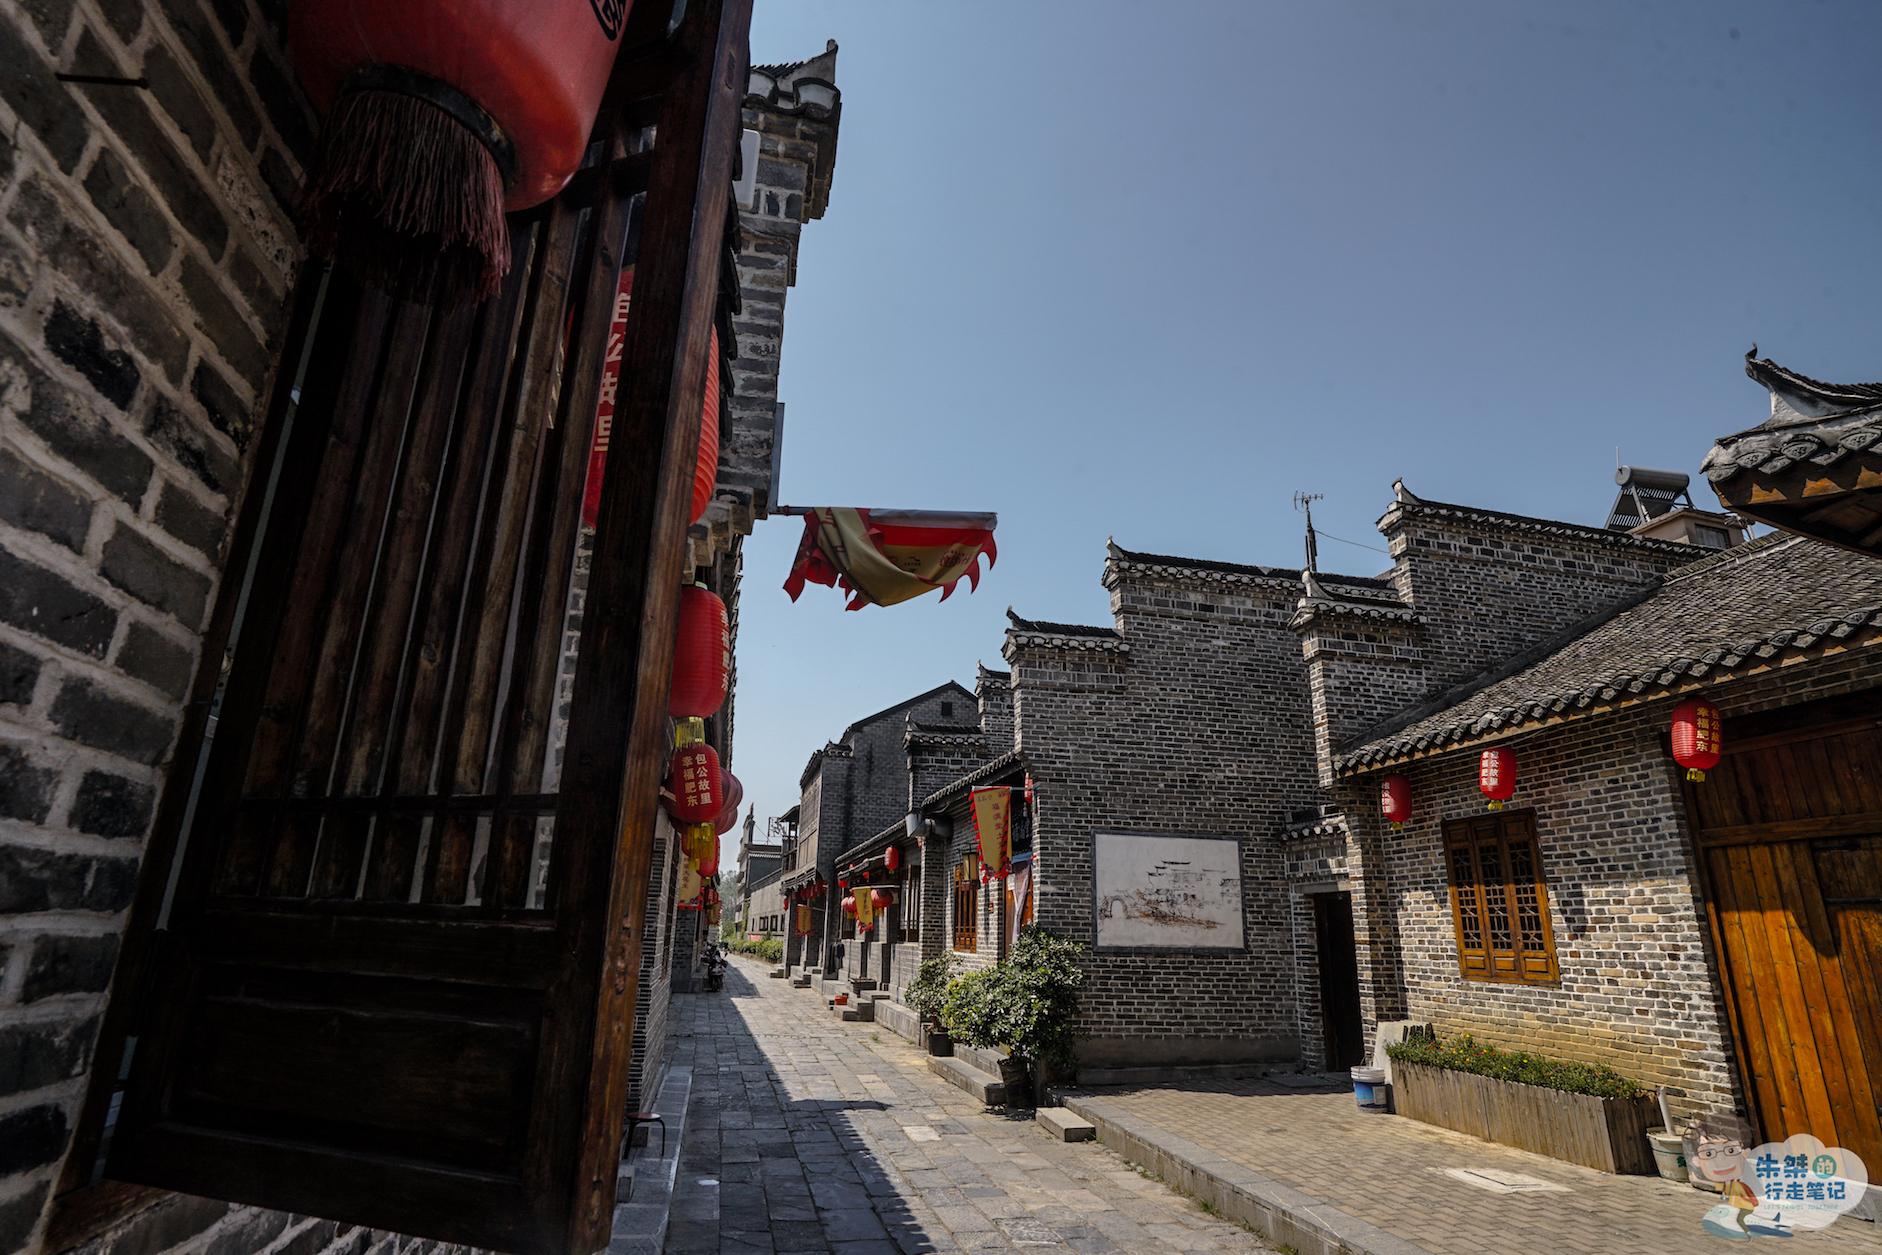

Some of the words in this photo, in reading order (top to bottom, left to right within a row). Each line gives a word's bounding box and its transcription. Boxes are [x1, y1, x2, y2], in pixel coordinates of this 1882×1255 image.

[681, 755, 699, 807] 幸福肥东
[695, 753, 712, 805] 包公故里
